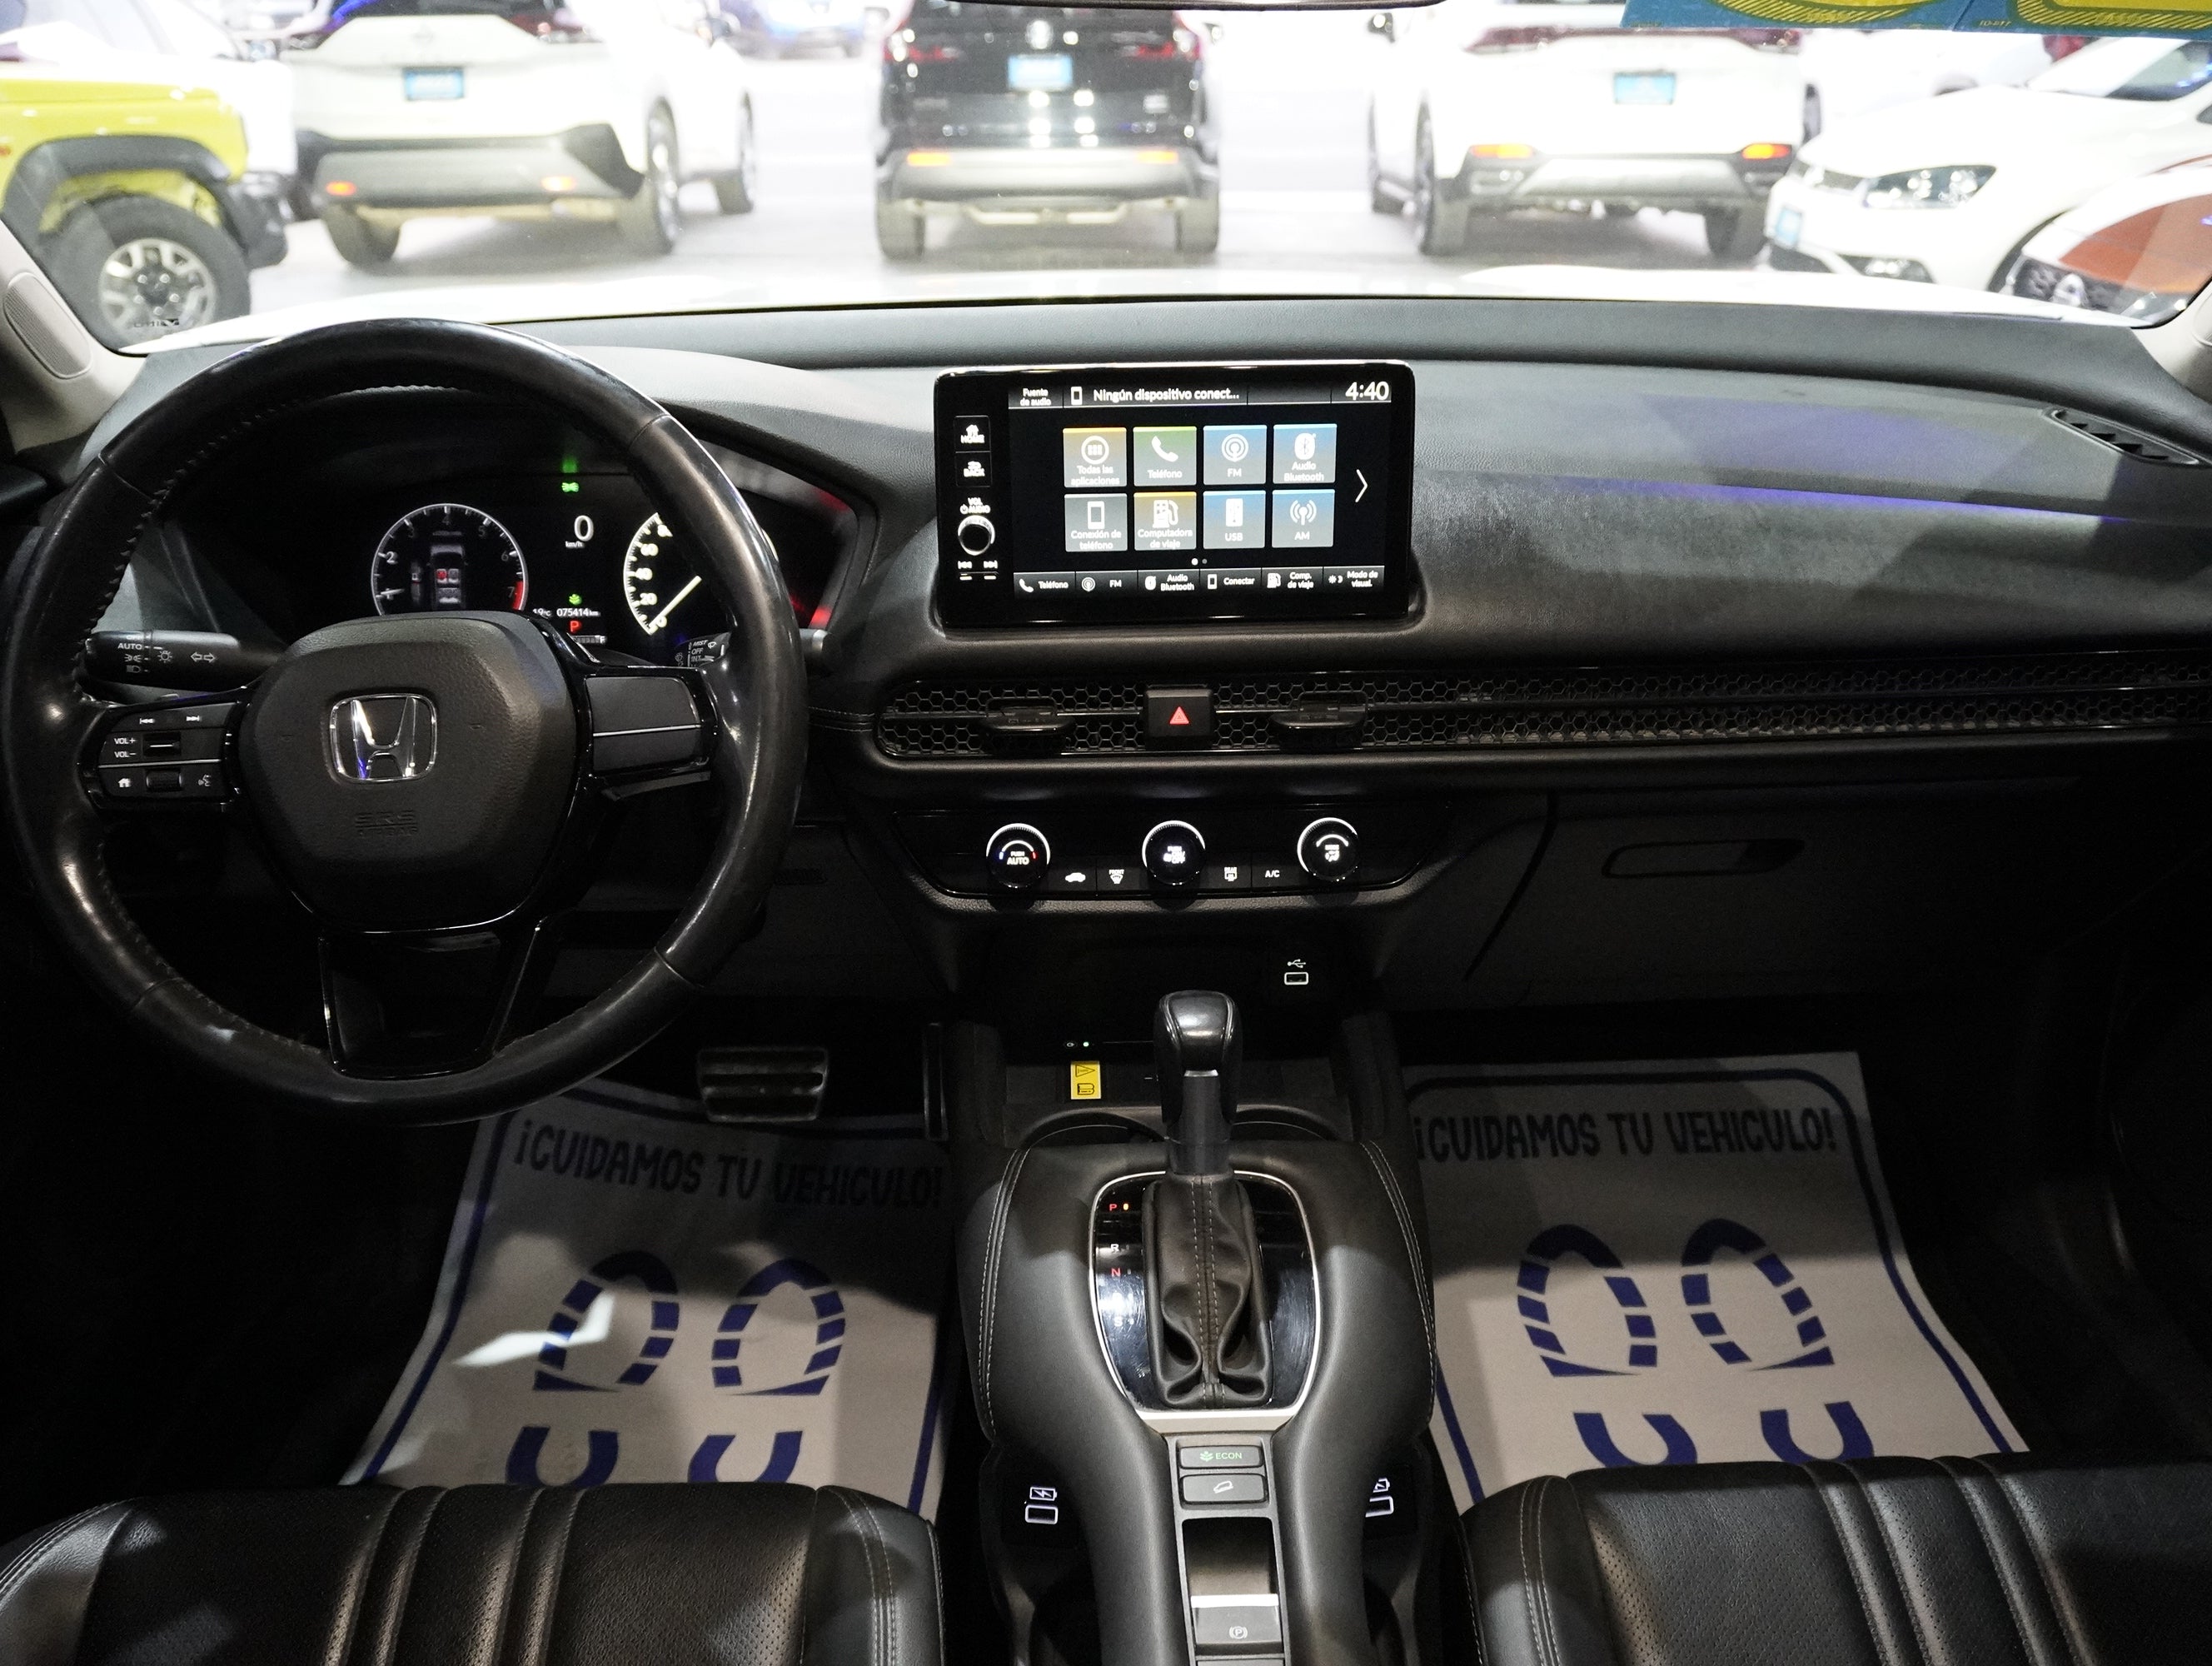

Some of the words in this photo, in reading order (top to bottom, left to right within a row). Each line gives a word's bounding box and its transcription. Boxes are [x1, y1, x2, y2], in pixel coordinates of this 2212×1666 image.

[1023, 388, 1049, 397] Fuente
[1094, 389, 1133, 403] Ningún
[1134, 388, 1193, 402] dispositivo
[1345, 382, 1389, 400] 4:40
[1020, 398, 1029, 407] de
[1031, 398, 1051, 407] audio
[1077, 465, 1101, 475] Todas
[1103, 465, 1114, 473] las
[1292, 461, 1317, 470] Audio
[1148, 468, 1183, 479] Teléfono
[1228, 468, 1242, 477] FM
[1283, 471, 1324, 481] Bluetooth
[1071, 476, 1119, 486] aplicaciones
[442, 516, 450, 526] 4
[574, 515, 594, 541] 0
[1071, 530, 1109, 540] Conexión
[1111, 530, 1122, 539] de
[1138, 528, 1193, 538] Computadora
[1225, 533, 1243, 541] USB
[1294, 531, 1310, 541] AM
[1079, 541, 1113, 550] teléfono
[1149, 540, 1161, 548] de
[1161, 540, 1181, 550] viaje
[386, 551, 397, 564] 2
[501, 553, 509, 561] 6
[1167, 574, 1188, 582] Audio
[1289, 571, 1313, 581] Comp.
[1347, 571, 1368, 579] Modo
[1369, 570, 1378, 578] de
[1109, 580, 1122, 588] FM
[1223, 576, 1255, 585] Conectar
[1298, 580, 1314, 590] viaje
[1351, 579, 1373, 588] visual.
[1038, 581, 1069, 590] Teléfono
[1161, 582, 1194, 591] Bluetooth
[507, 586, 515, 598] 7
[556, 608, 589, 616] 075414
[570, 620, 580, 633] P
[1006, 856, 1029, 865] AUTO
[1265, 870, 1279, 878] A/C
[1413, 1112, 1601, 1163] ¡CUIDAMOS
[1607, 1111, 1654, 1156] TU
[1664, 1106, 1837, 1155] VEHICULO!
[514, 1120, 705, 1195] ¡CUIDAMOS
[773, 1162, 944, 1208] VEHICULO!
[1111, 1244, 1119, 1253] R
[1111, 1268, 1121, 1277] N
[1114, 1317, 1123, 1326] S
